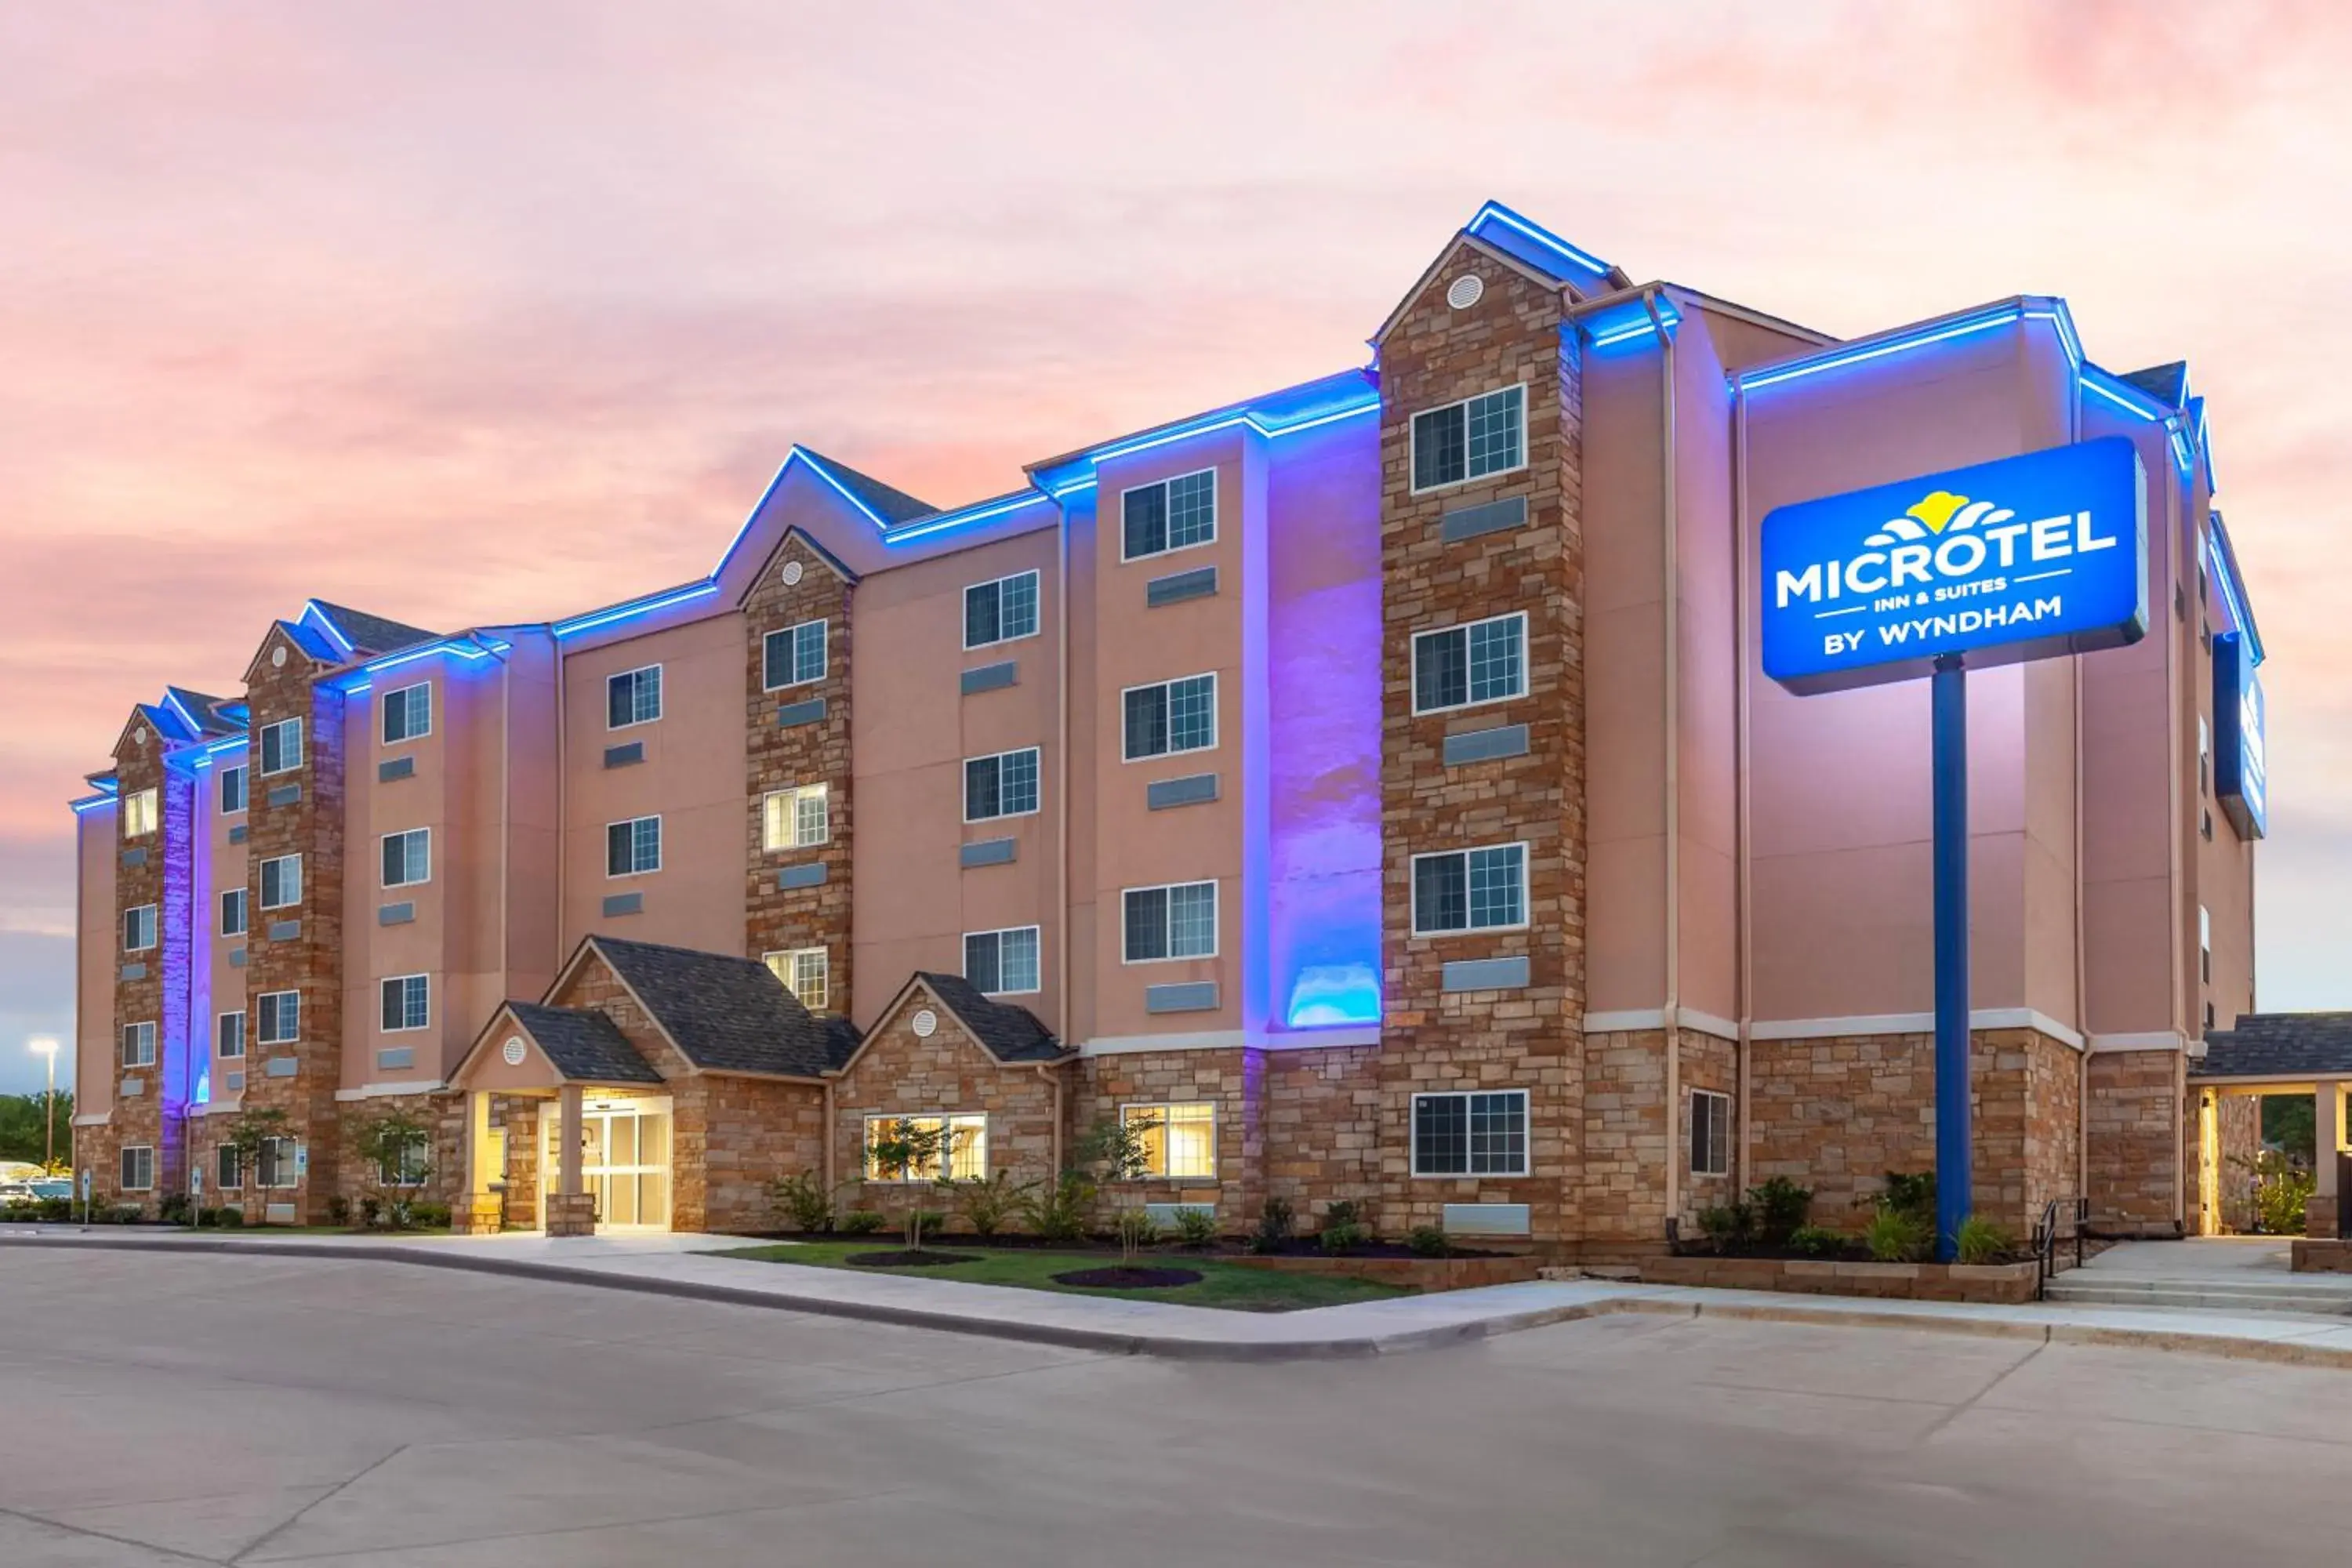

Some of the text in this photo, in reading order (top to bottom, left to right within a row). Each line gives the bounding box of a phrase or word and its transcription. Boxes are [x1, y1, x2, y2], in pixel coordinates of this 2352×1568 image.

[1776, 510, 2117, 608] MICROTEL
[1874, 576, 2008, 612] INN & SUITES
[1824, 595, 2062, 655] BY WYNDHAM
